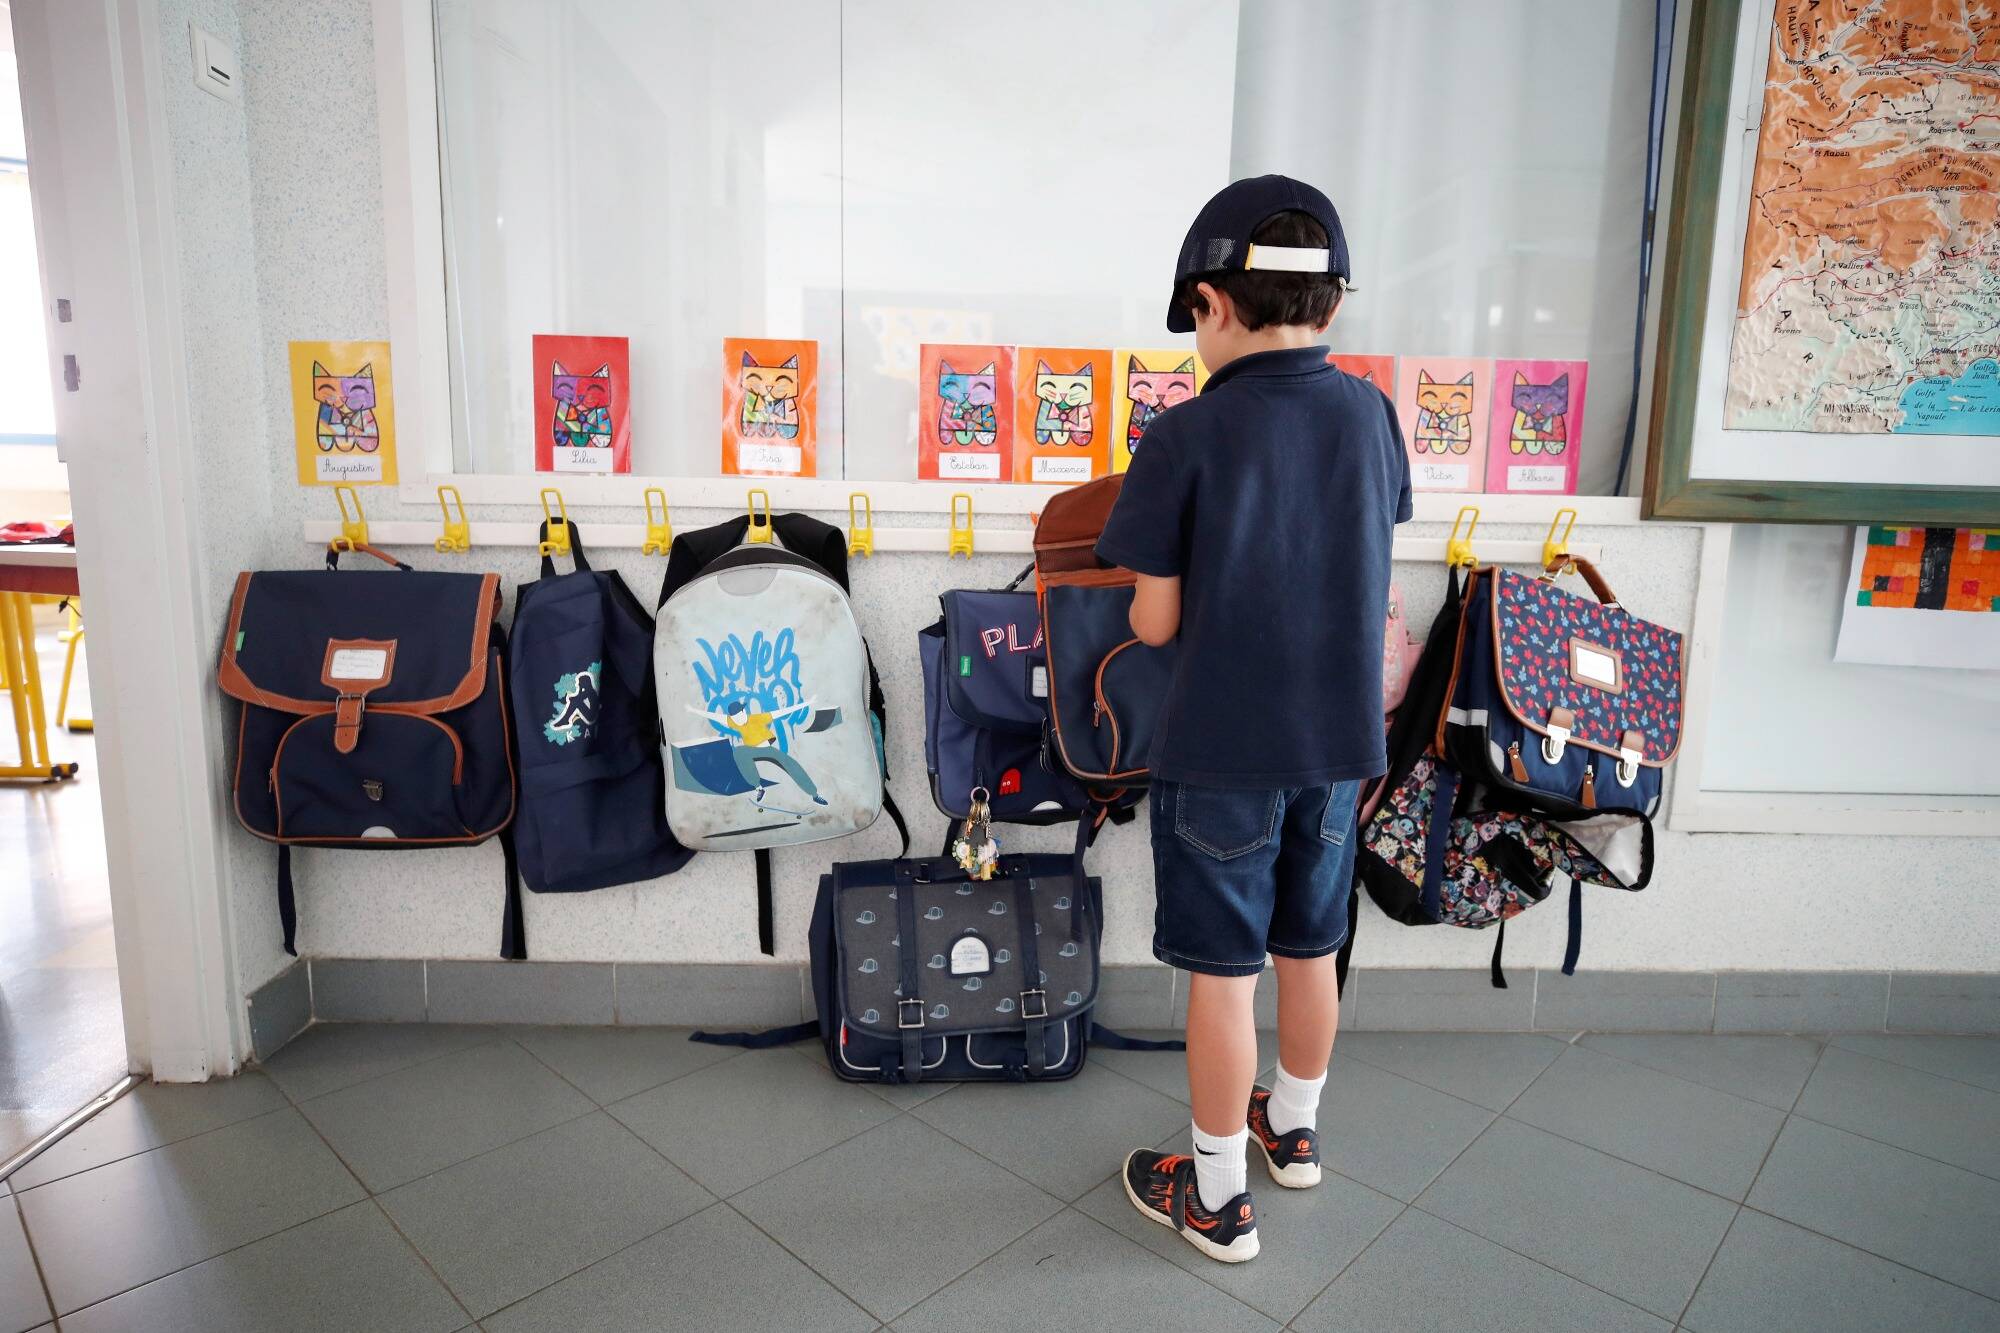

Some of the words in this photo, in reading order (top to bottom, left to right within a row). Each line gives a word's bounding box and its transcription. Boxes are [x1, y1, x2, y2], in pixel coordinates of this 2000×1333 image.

[1915, 389, 1937, 398] Golfe
[323, 458, 375, 480] Augustin
[949, 455, 989, 470] Esteban
[1038, 460, 1088, 474] Maxence
